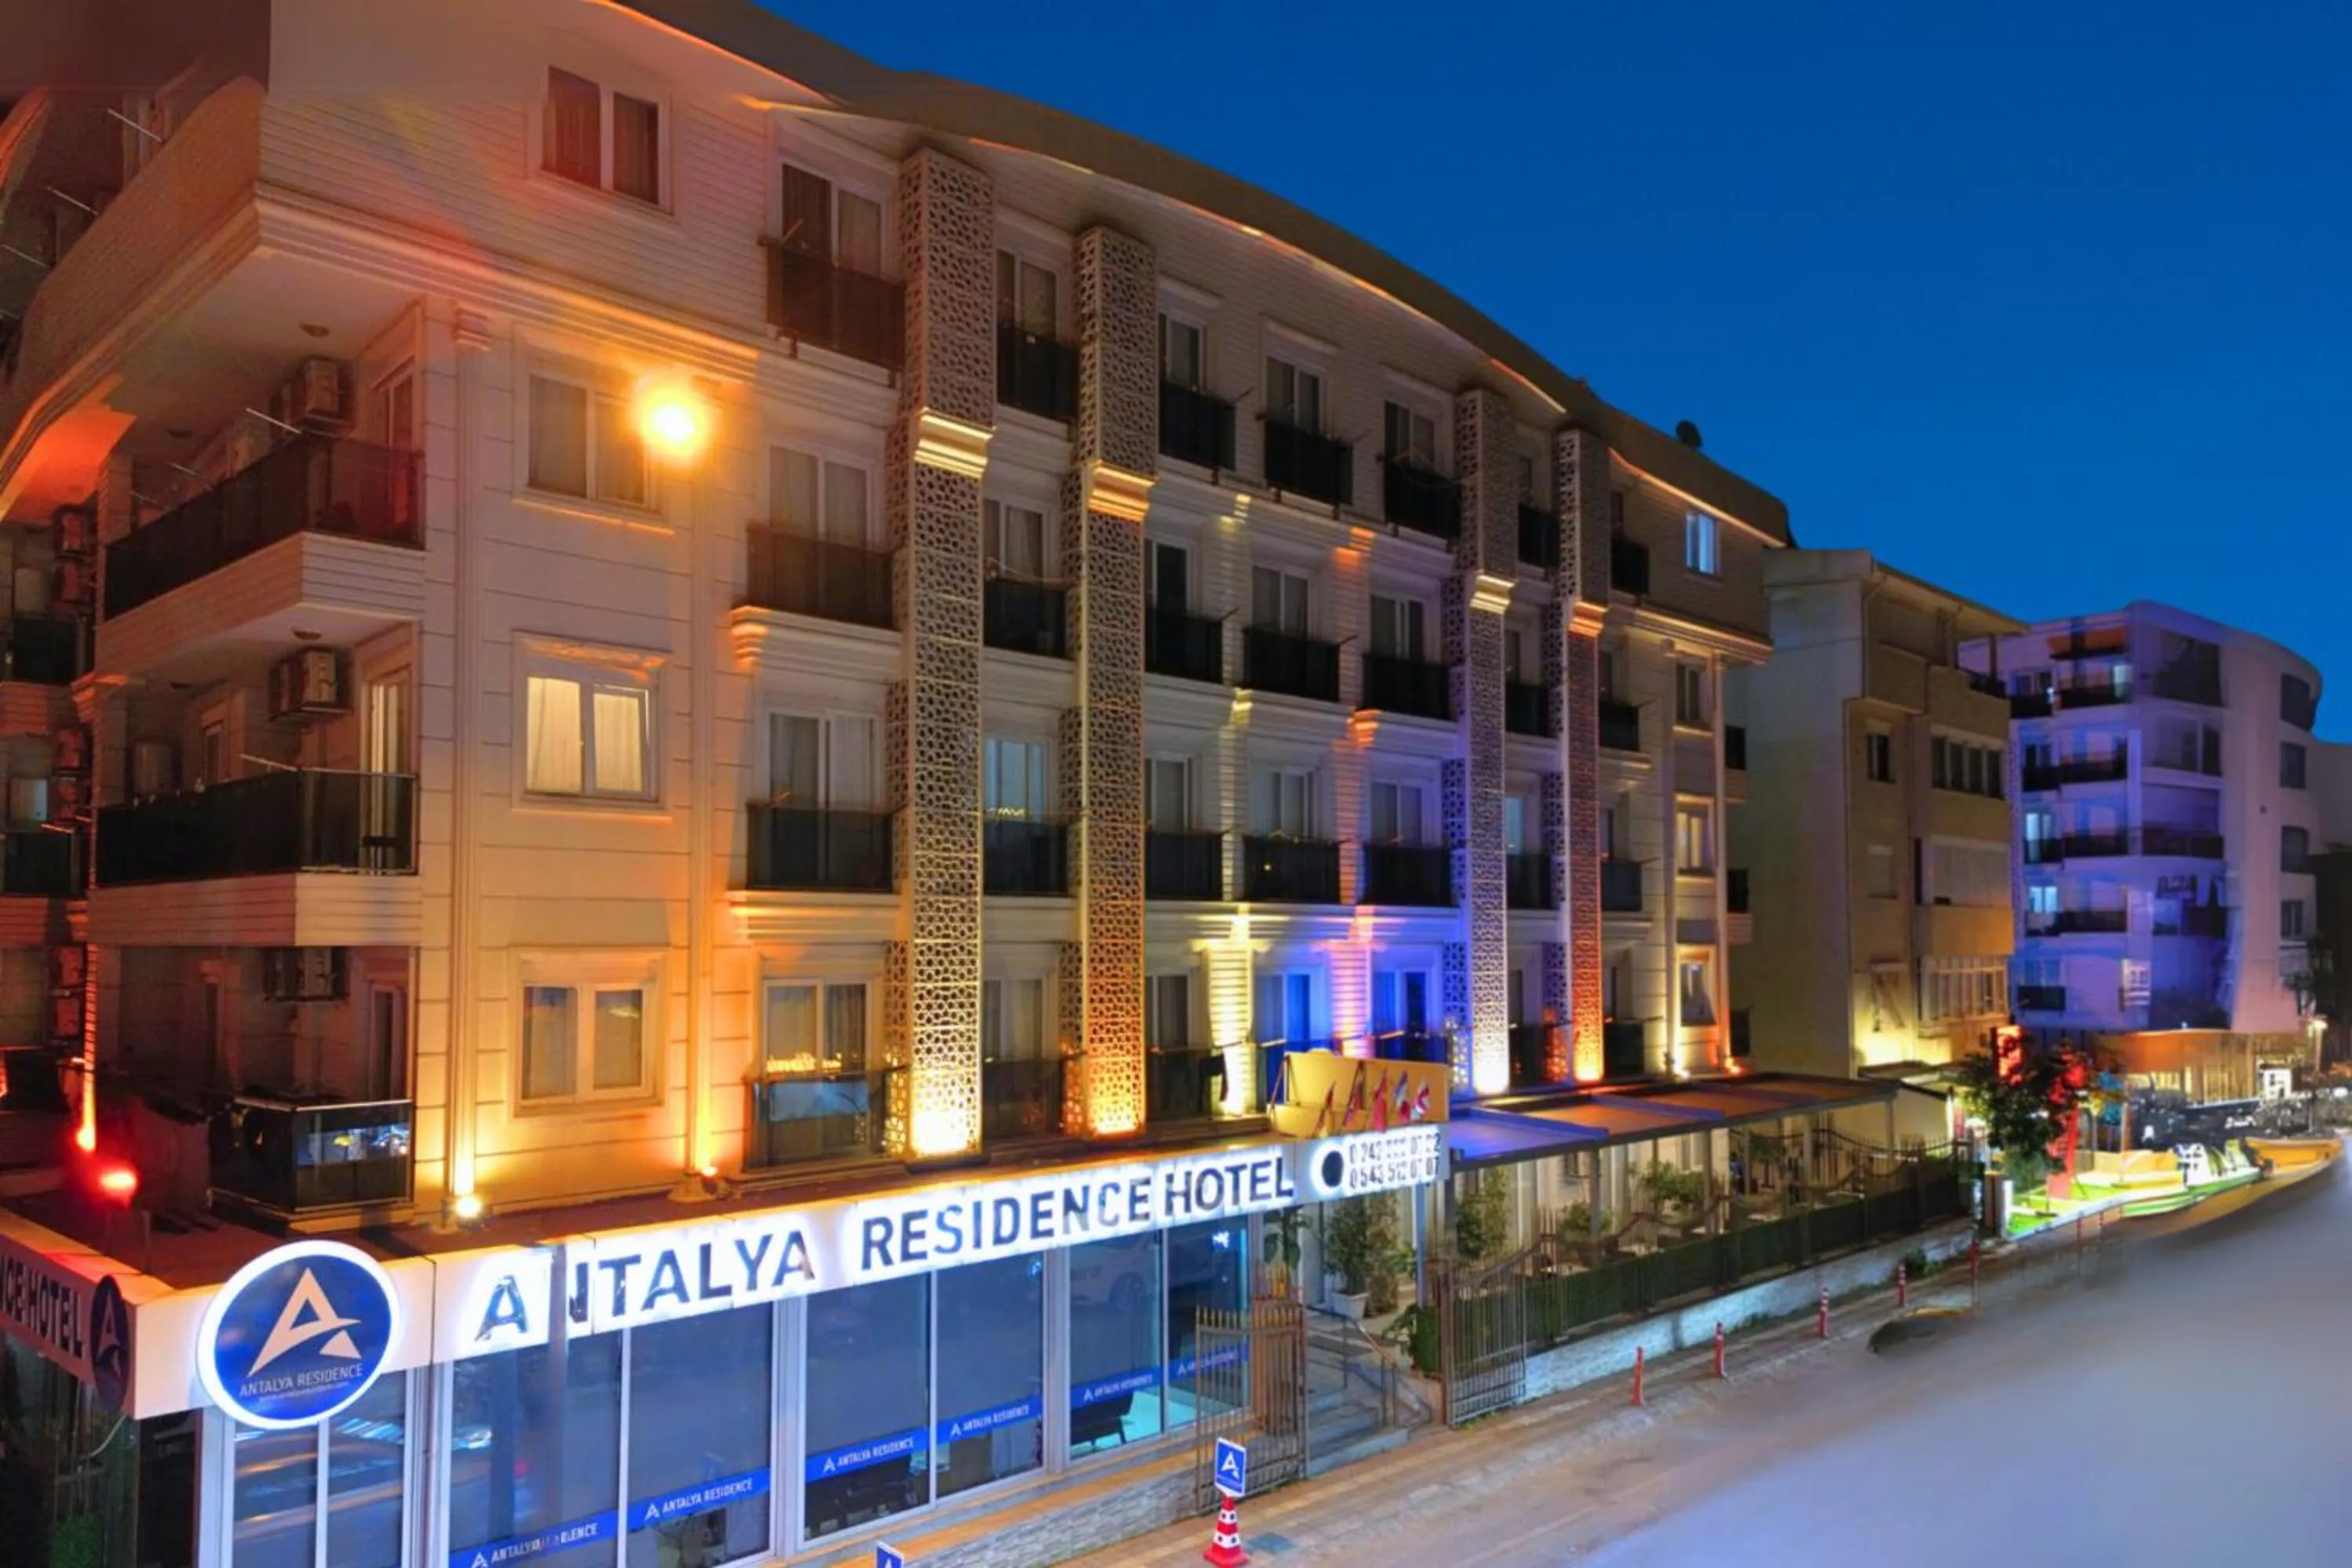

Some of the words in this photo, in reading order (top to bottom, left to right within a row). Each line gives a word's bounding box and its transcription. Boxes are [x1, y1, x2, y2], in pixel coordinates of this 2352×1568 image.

[861, 1177, 1152, 1272] RESIDENCE
[1165, 1156, 1294, 1216] HOTEL
[28, 1269, 83, 1359] HOTEL
[239, 1375, 293, 1399] ANTALYA
[296, 1363, 364, 1388] RESIDENCE
[837, 1448, 871, 1468] ANTALYA
[873, 1436, 913, 1457] RESIDENCE
[662, 1493, 702, 1514] ANTALYA
[703, 1478, 753, 1501] RESIDENCE
